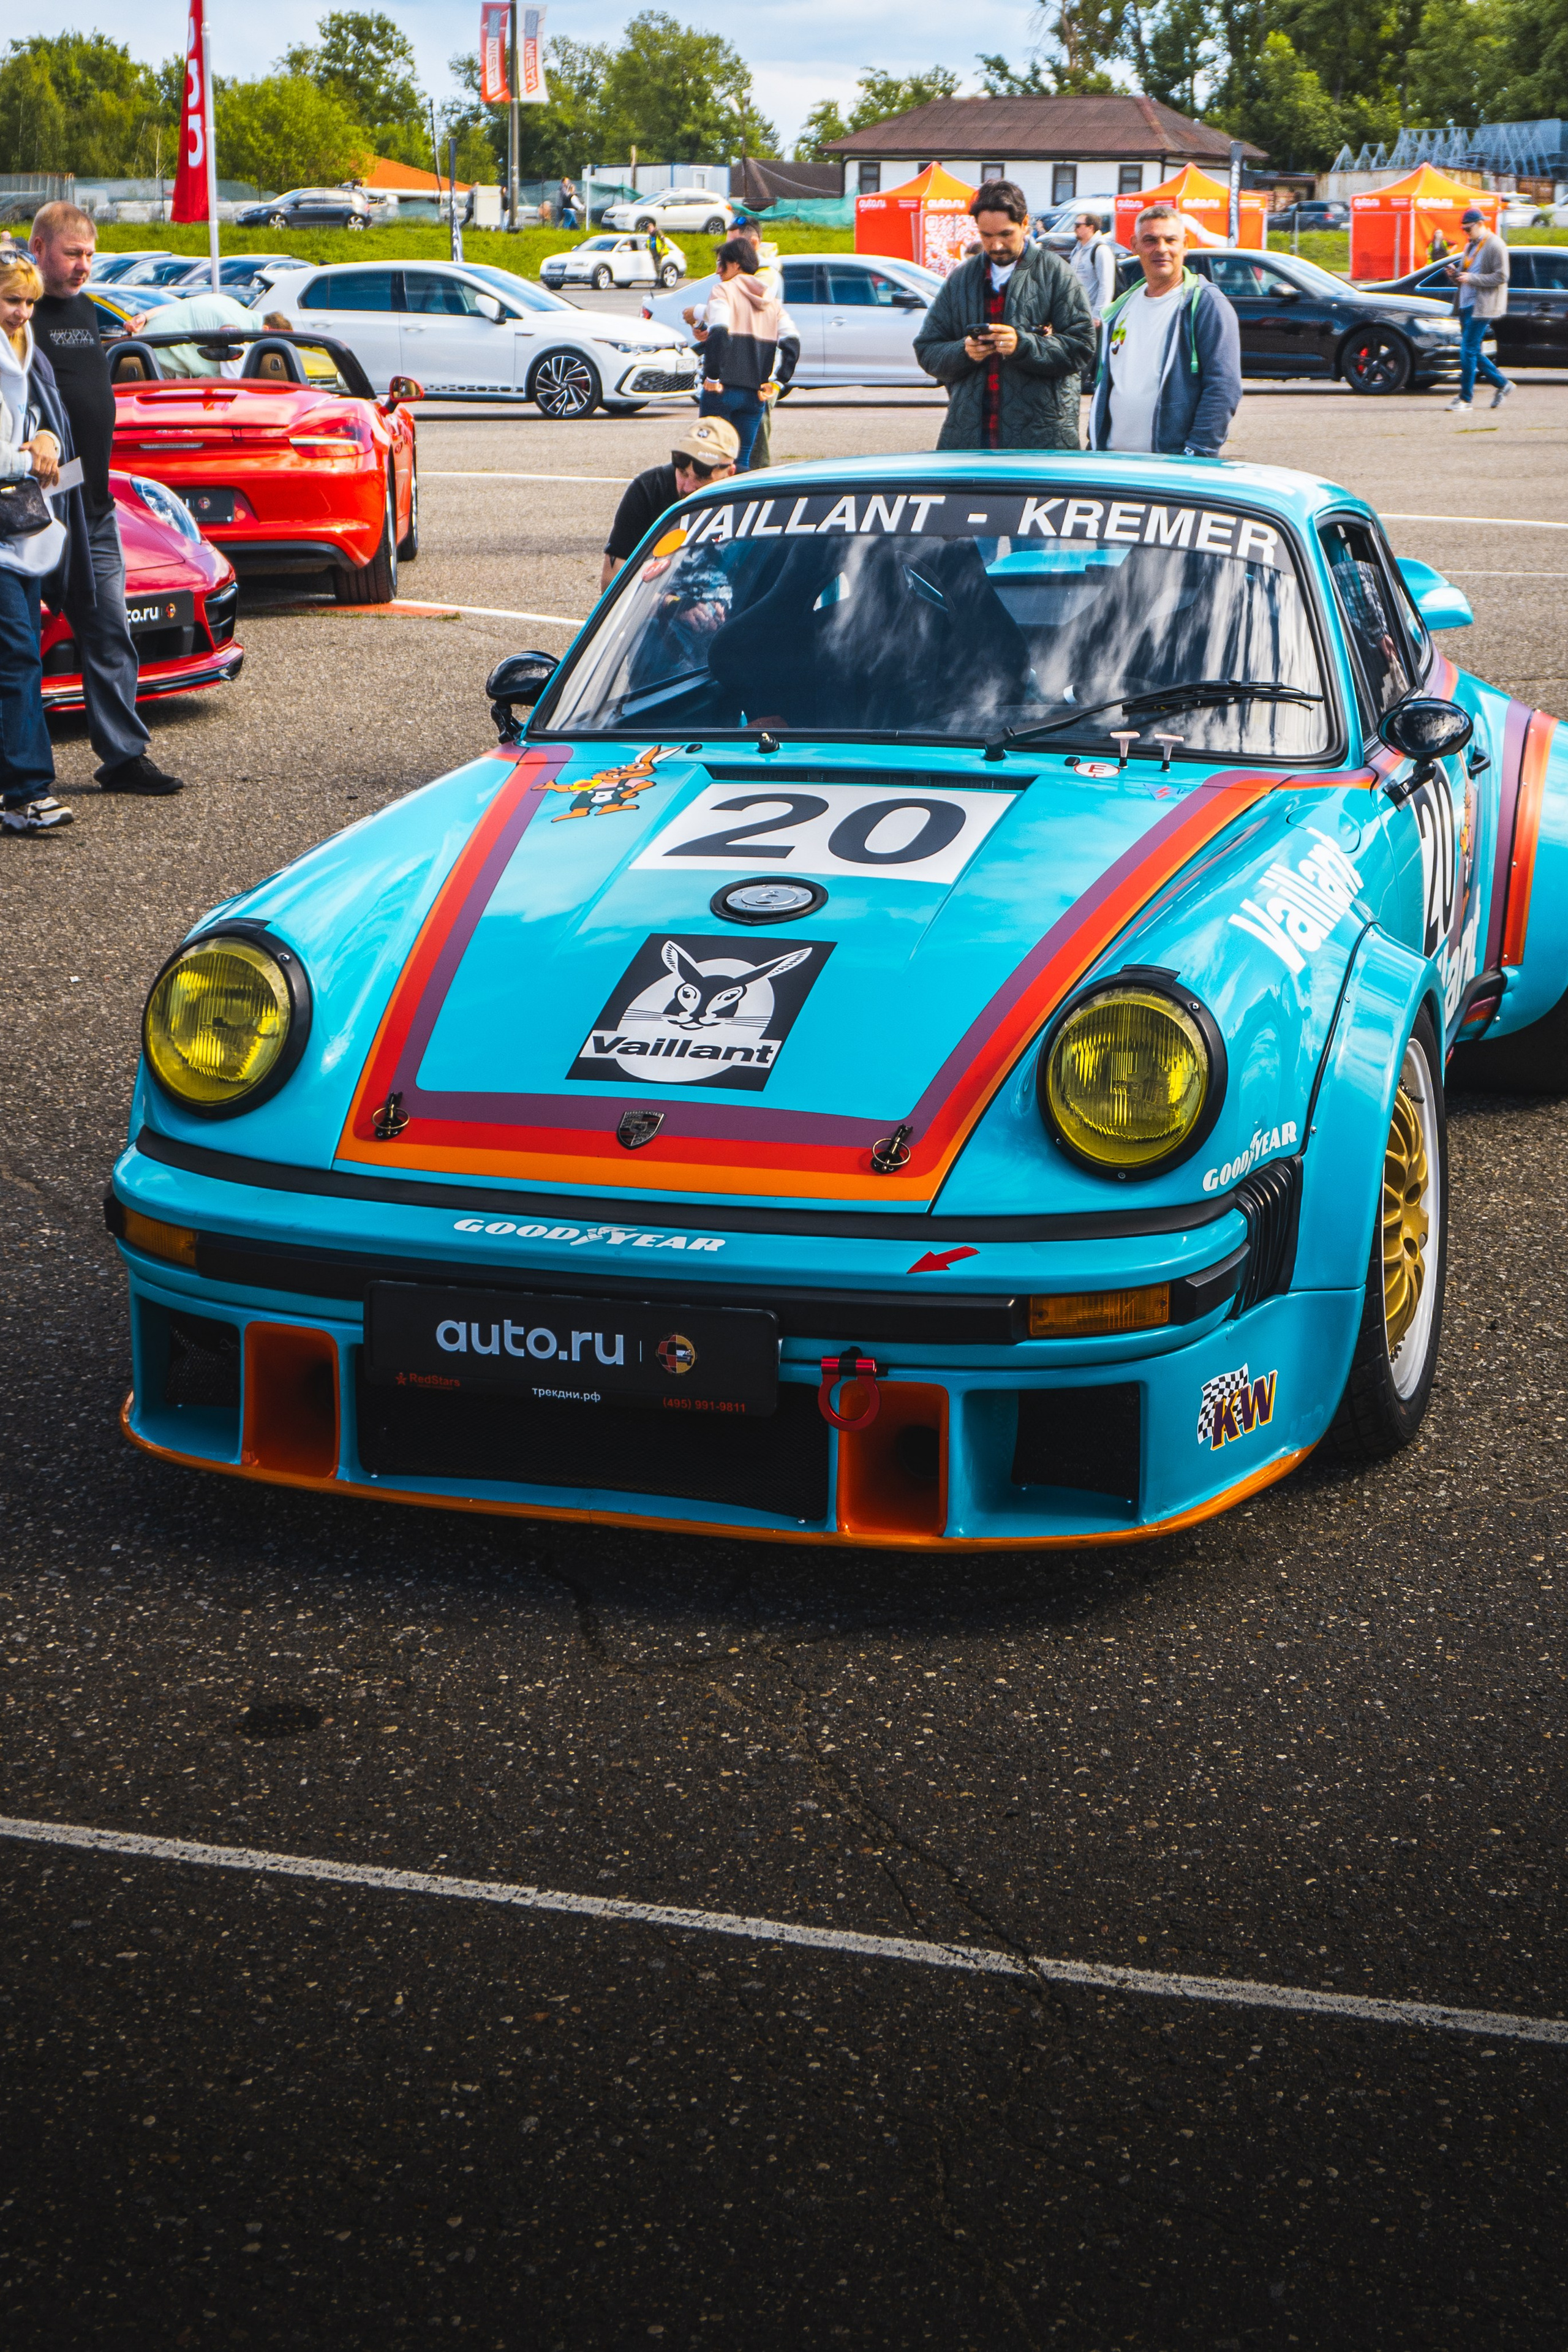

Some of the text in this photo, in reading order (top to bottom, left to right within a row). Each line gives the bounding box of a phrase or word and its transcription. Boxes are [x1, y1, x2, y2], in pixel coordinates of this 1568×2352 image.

[489, 40, 498, 89] VASIN
[526, 40, 537, 90] VASIN
[927, 198, 966, 209] auto.ru
[680, 494, 945, 546] VAILLANT
[1017, 497, 1279, 565] KREMER
[662, 793, 967, 865] 20
[1227, 827, 1364, 974] Vaillant
[592, 1035, 774, 1064] Vaillant
[1202, 1120, 1297, 1192] GOODYEAR
[453, 1219, 726, 1252] GOODYEAR
[435, 1319, 624, 1365] auto.ru
[409, 1373, 461, 1387] RedStars
[532, 1387, 601, 1403] трекдни.рф
[663, 1396, 745, 1412] (495) 991-9811
[1211, 1369, 1278, 1450] KW
